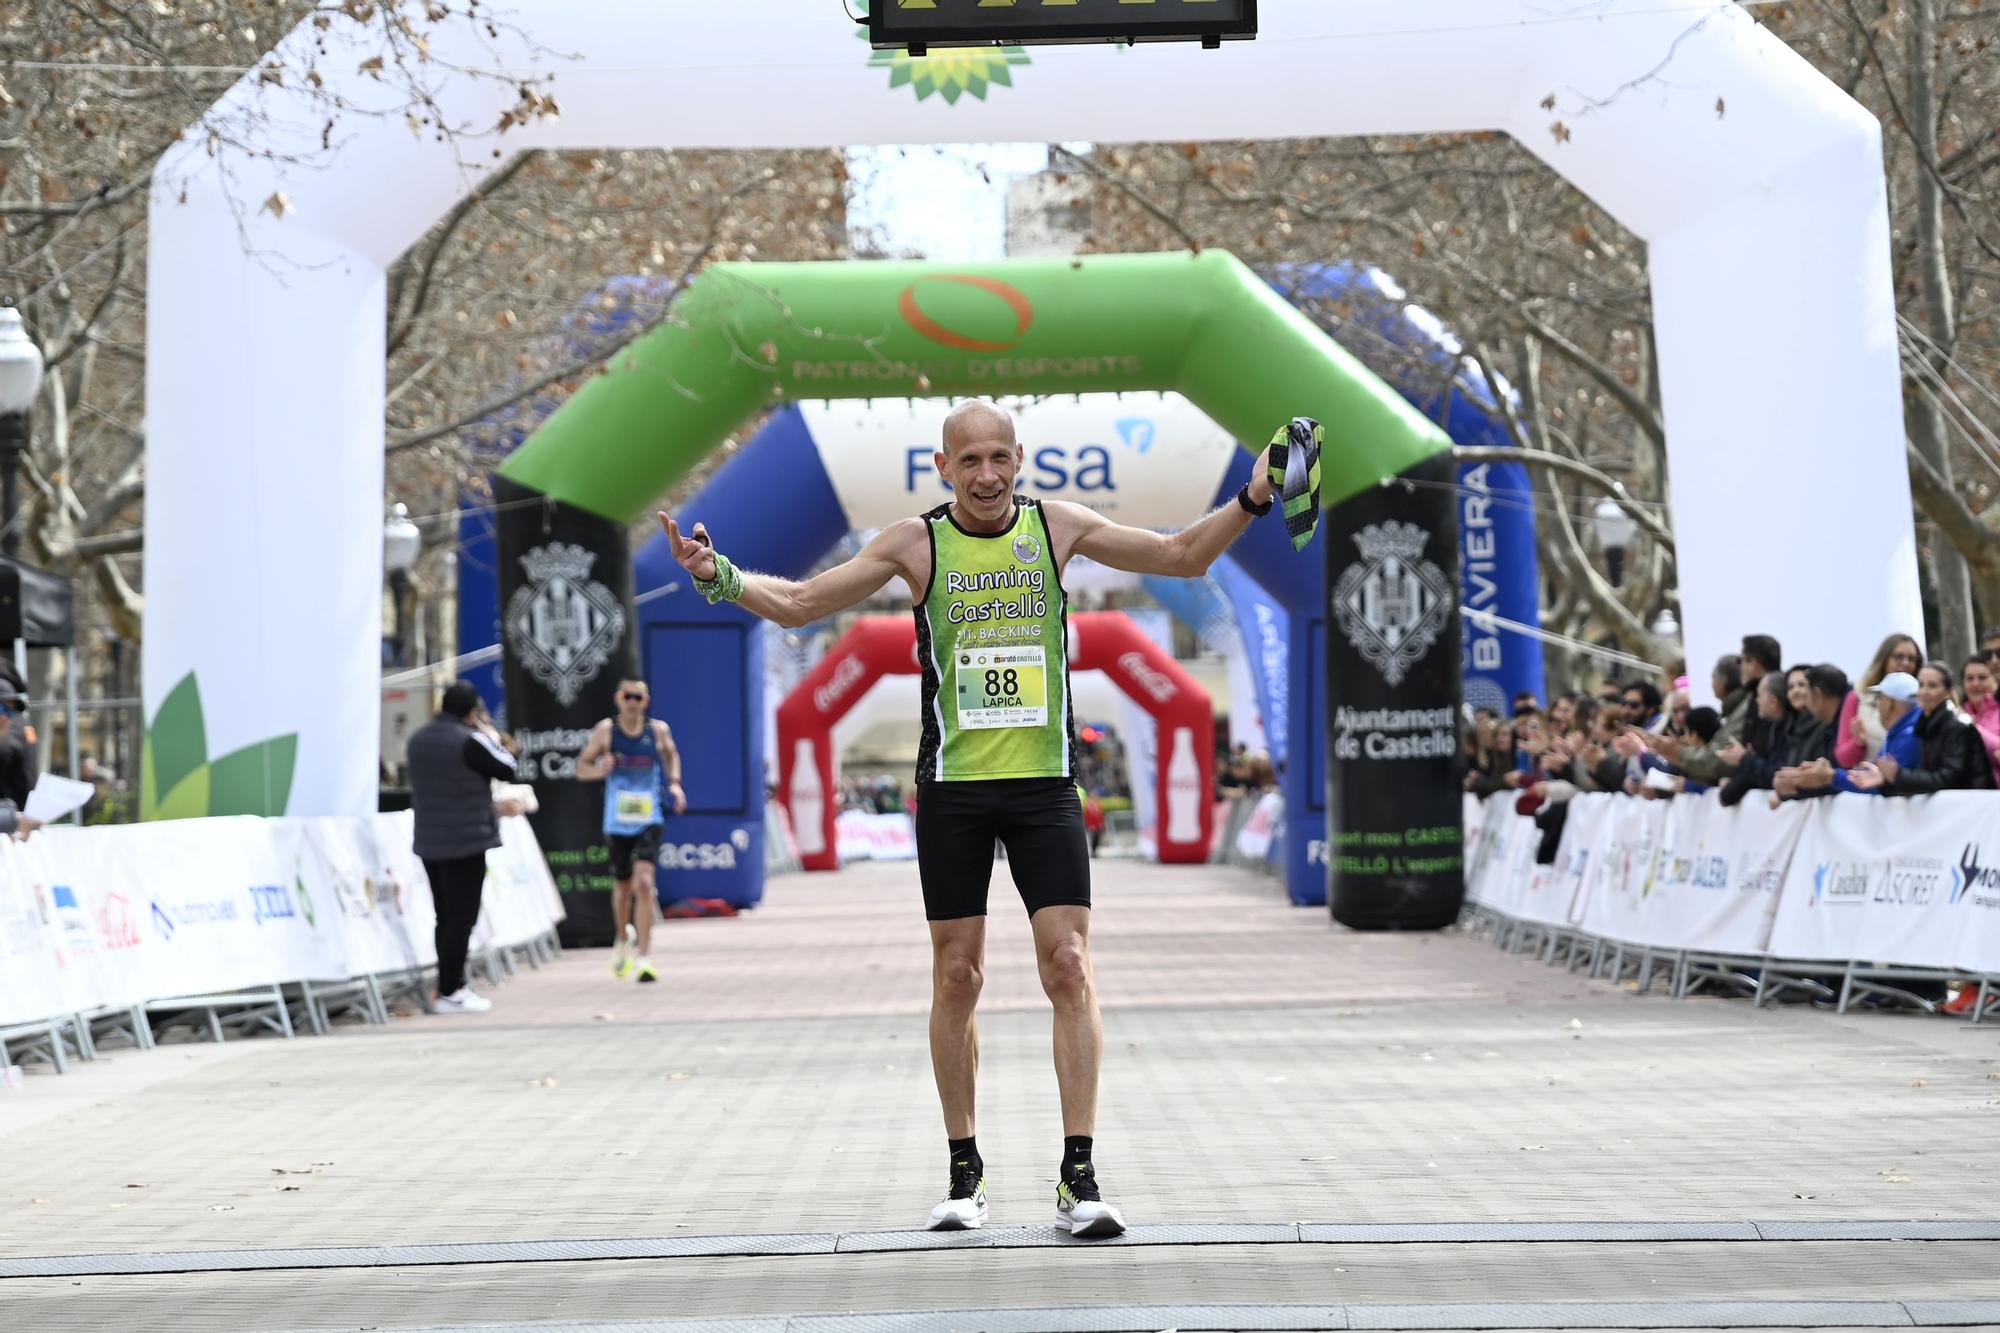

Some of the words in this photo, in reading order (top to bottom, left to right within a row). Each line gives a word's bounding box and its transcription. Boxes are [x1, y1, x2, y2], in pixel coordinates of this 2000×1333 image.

[966, 355, 1142, 378] D'ESPORTS
[905, 445, 1118, 493] Fsa
[946, 565, 1044, 595] Running
[1463, 463, 1502, 671] BAVIERA
[946, 592, 1047, 624] Castelló
[979, 624, 1042, 640] BACKING
[984, 668, 1018, 697] 88
[982, 696, 1023, 708] LAPICA
[1334, 706, 1456, 732] Ajuntament
[1335, 731, 1361, 760] de
[1364, 730, 1457, 760] Castelló
